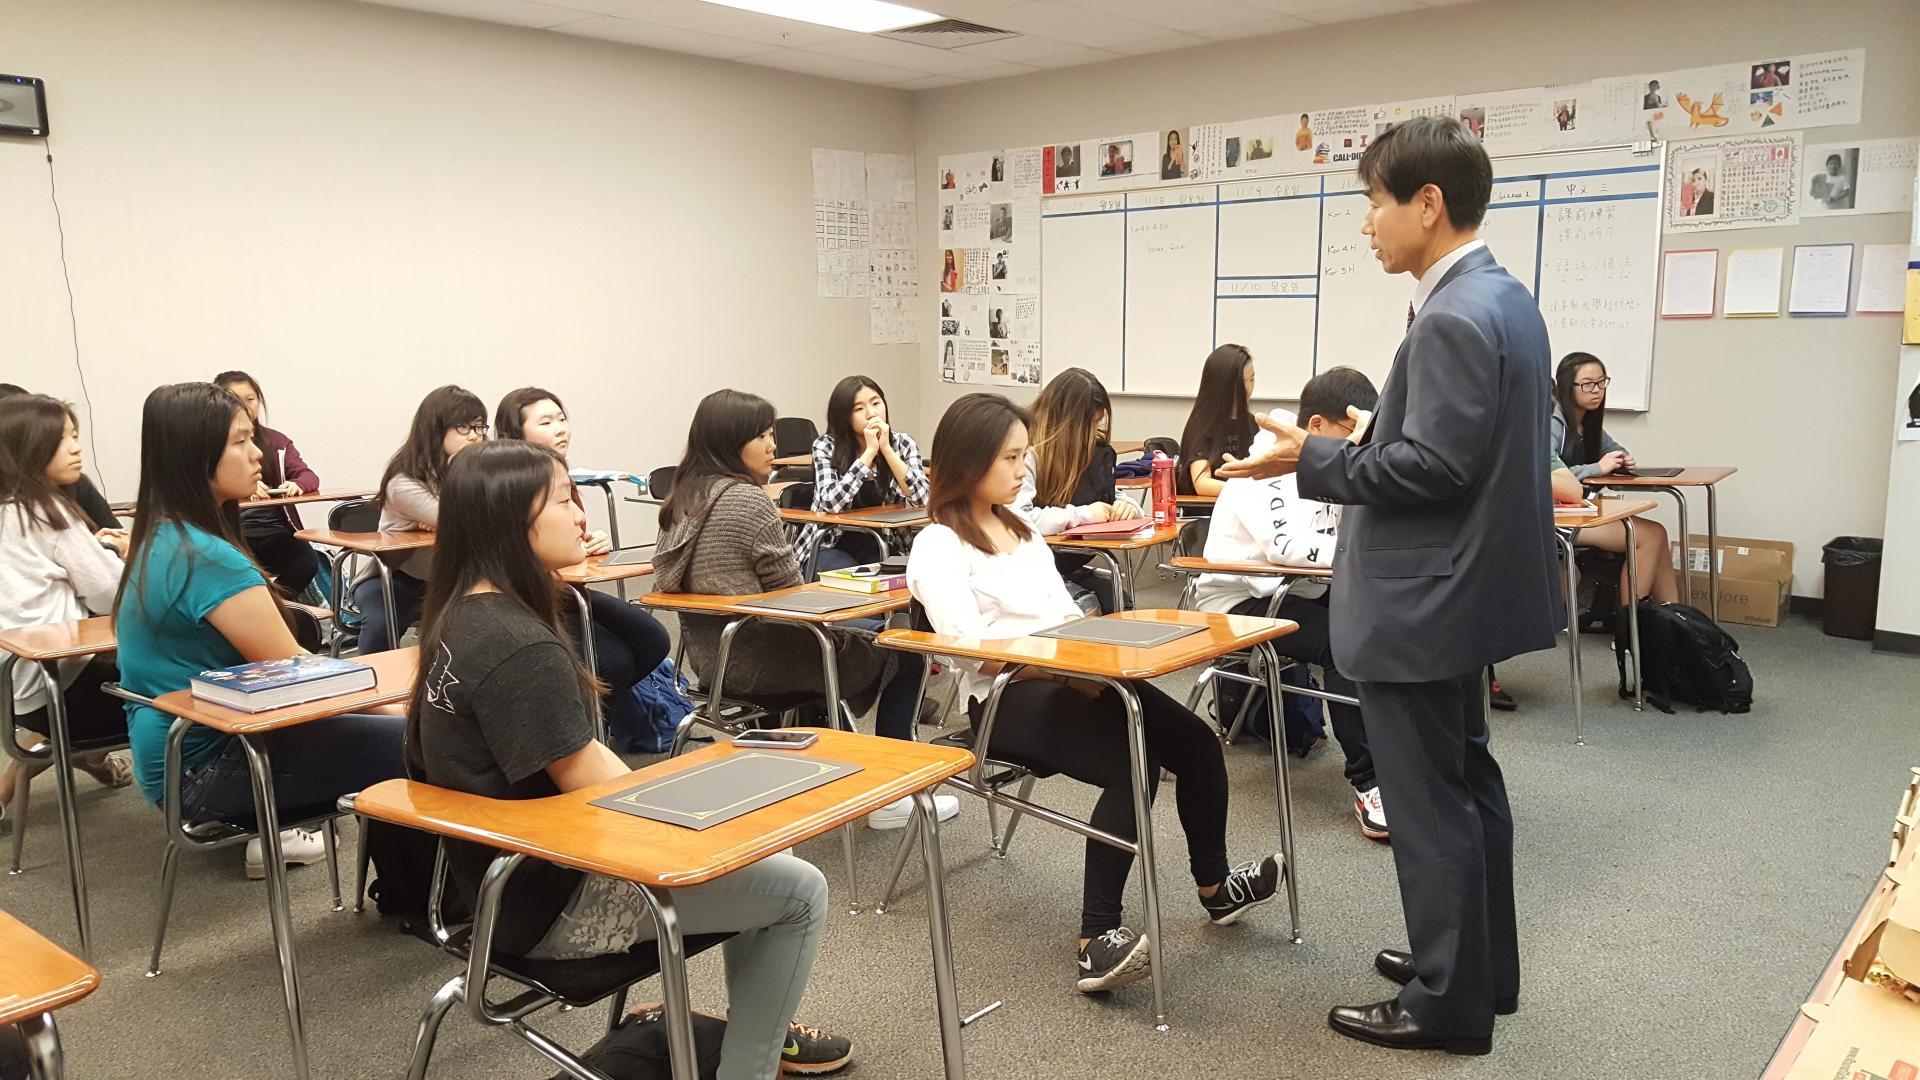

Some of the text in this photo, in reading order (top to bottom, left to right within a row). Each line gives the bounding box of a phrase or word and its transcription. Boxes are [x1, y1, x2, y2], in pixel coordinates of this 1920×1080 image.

[1333, 153, 1350, 162] CALL
[1327, 244, 1340, 255] Kor
[1325, 267, 1337, 275] Kor
[1690, 588, 1750, 605] exlore
